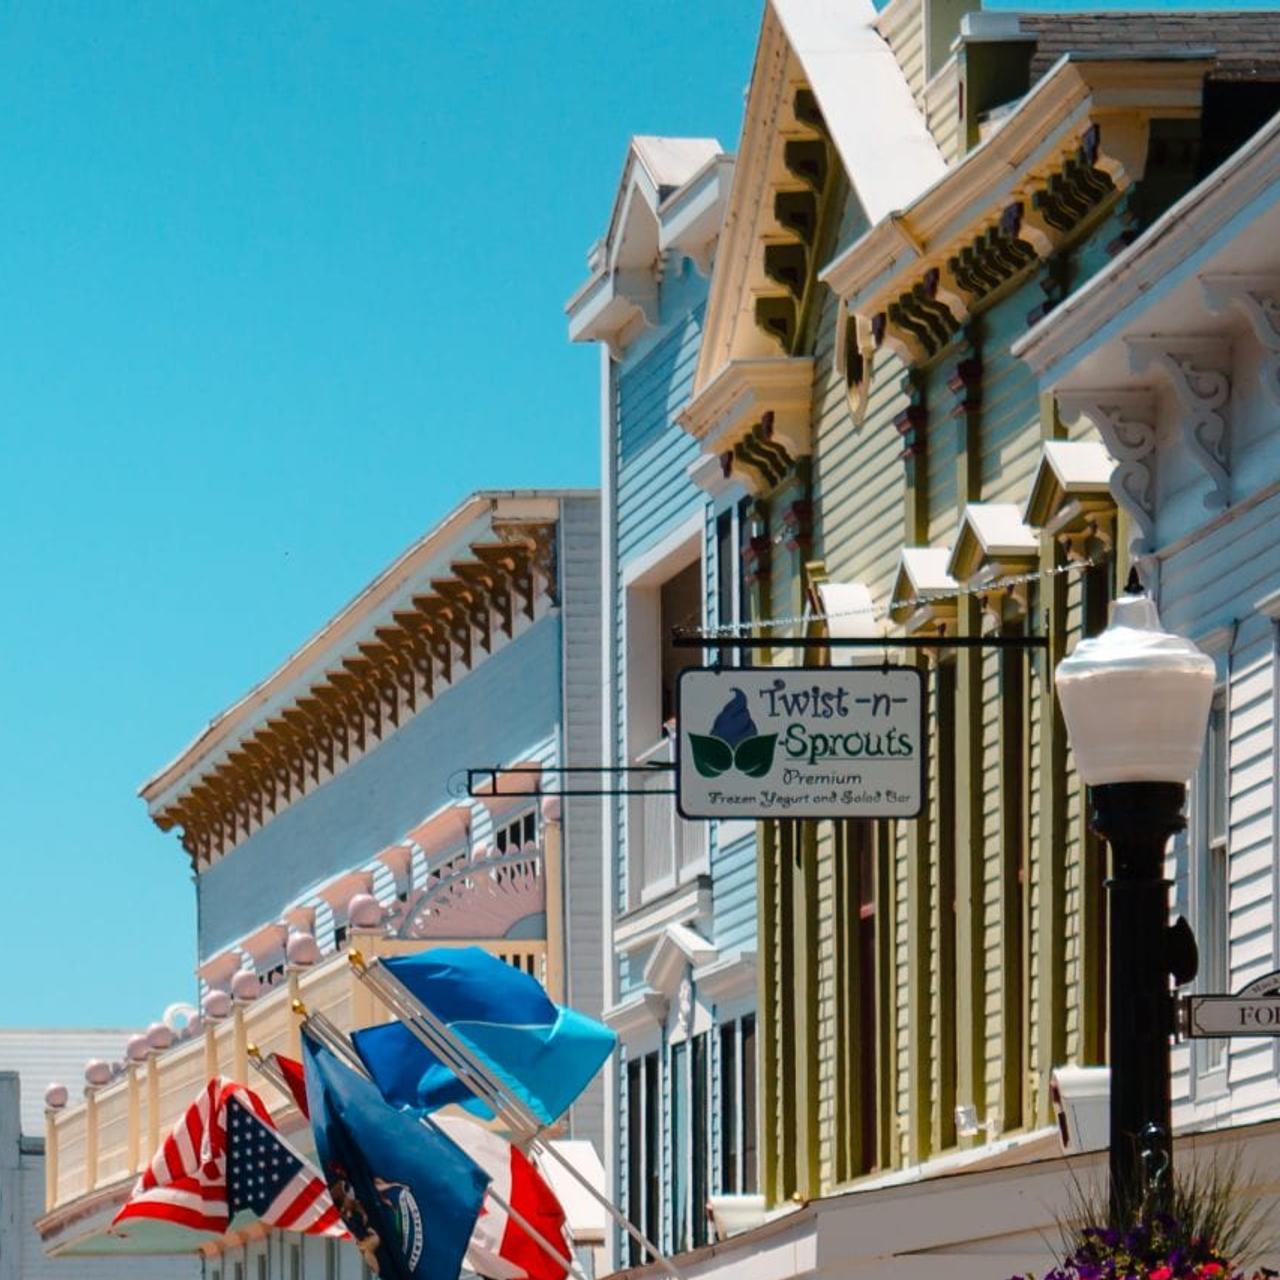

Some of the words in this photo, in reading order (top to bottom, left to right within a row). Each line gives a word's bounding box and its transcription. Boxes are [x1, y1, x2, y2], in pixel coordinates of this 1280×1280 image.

[759, 679, 849, 719] Twist
[778, 723, 914, 766] Sprouts
[783, 768, 862, 786] Premium
[708, 791, 756, 804] Frozen
[810, 791, 837, 804] and
[840, 790, 881, 805] Salad
[885, 790, 912, 803] Bar
[1240, 1006, 1280, 1025] FO
